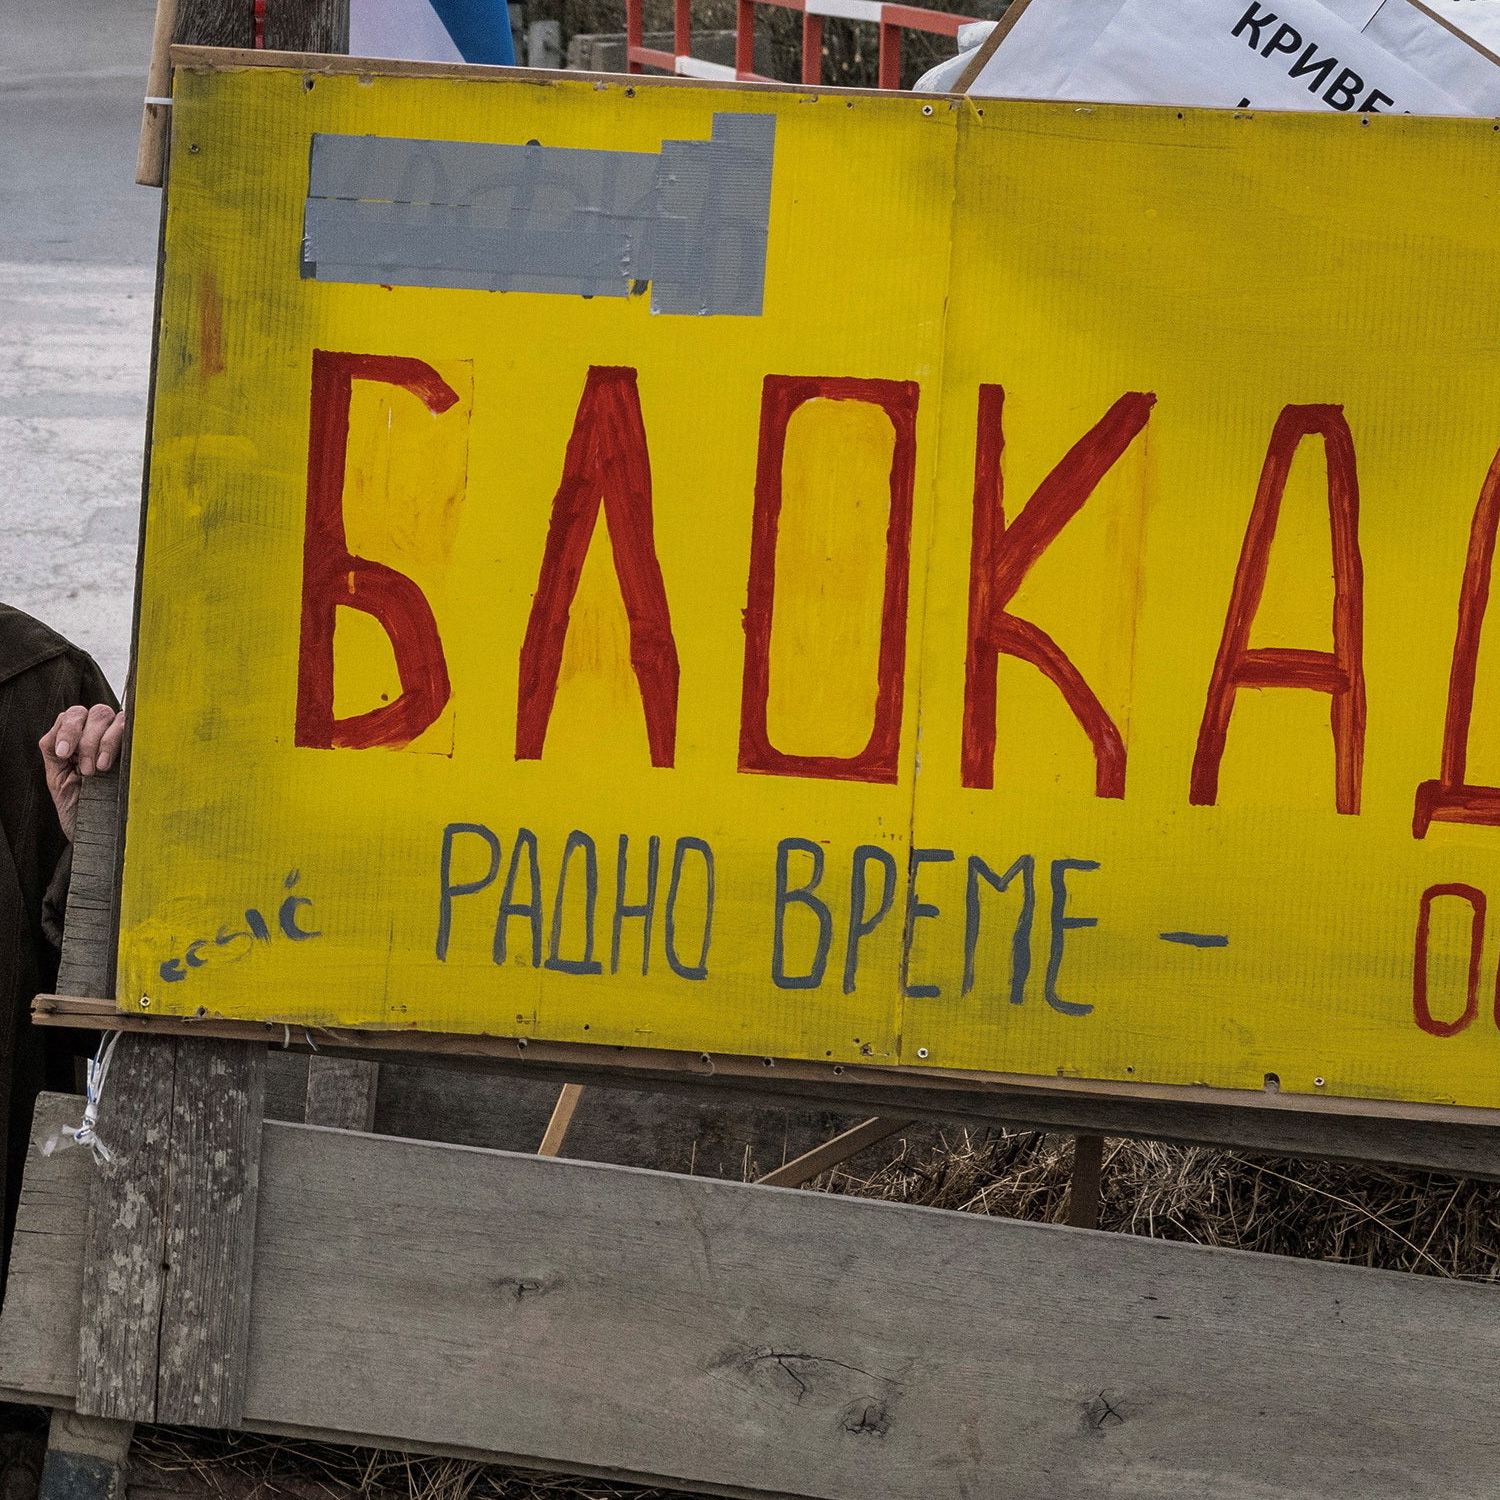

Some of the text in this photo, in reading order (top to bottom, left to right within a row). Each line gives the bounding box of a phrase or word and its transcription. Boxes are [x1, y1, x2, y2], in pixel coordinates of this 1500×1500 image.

[1230, 0, 1411, 113] КРИВЕ
[435, 822, 714, 980] РАДНО
[771, 836, 1101, 1016] ВРЕМЕ
